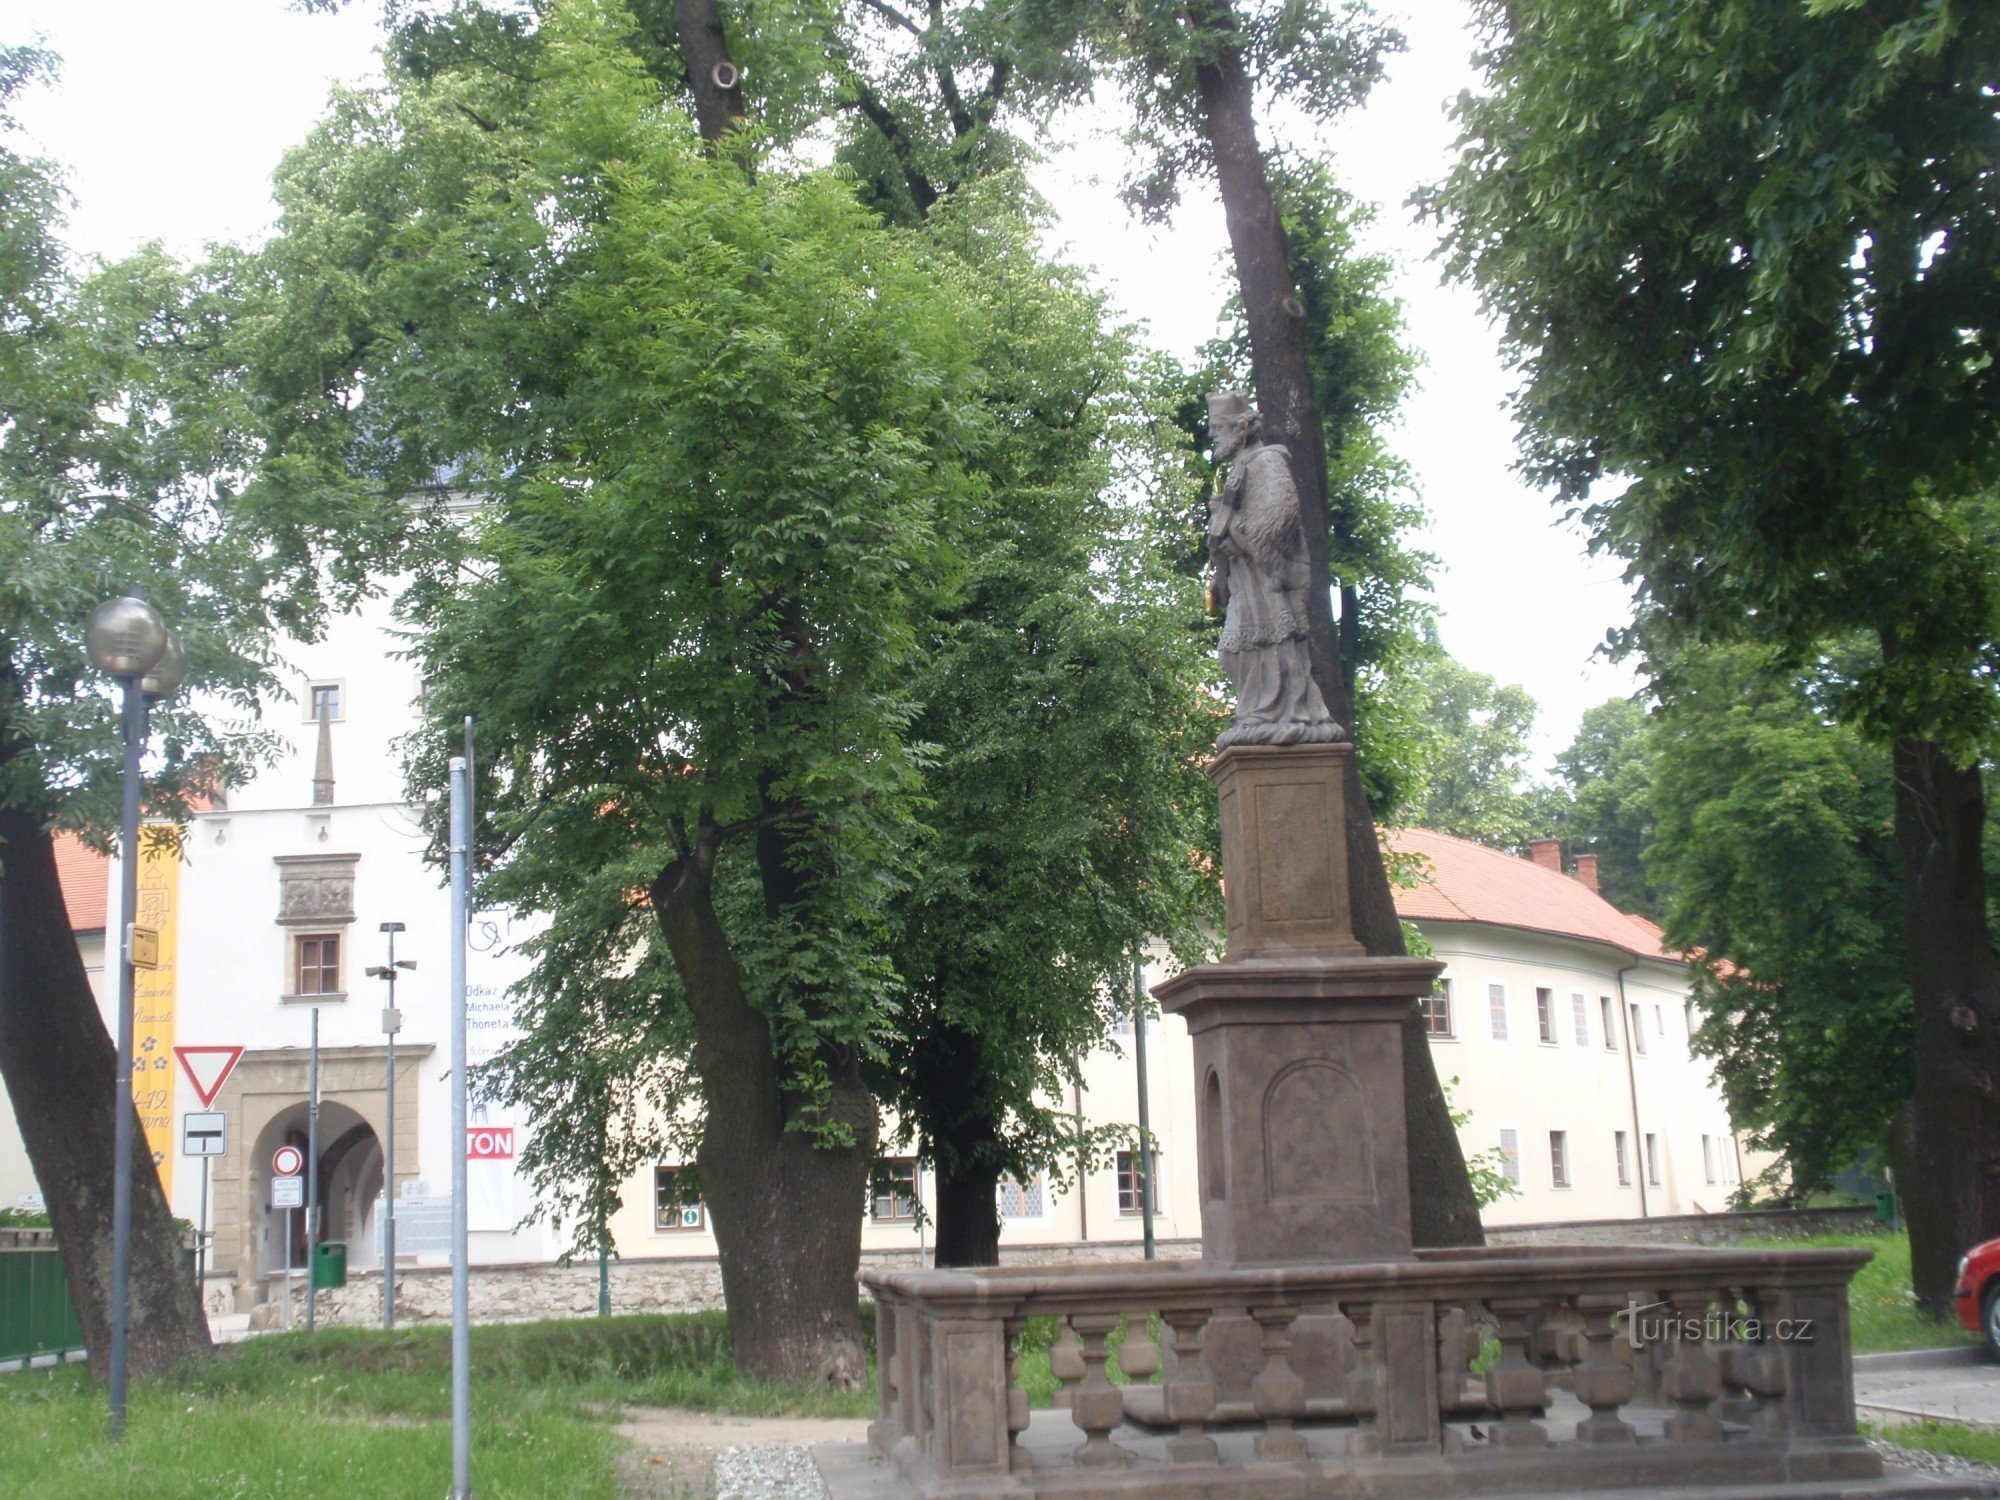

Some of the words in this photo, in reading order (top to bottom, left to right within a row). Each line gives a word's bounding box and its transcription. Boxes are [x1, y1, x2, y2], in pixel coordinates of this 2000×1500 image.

[466, 984, 497, 997] Odkaz
[466, 1002, 510, 1013] Michaela
[466, 1017, 509, 1030] Thoneta
[467, 1132, 512, 1155] TON
